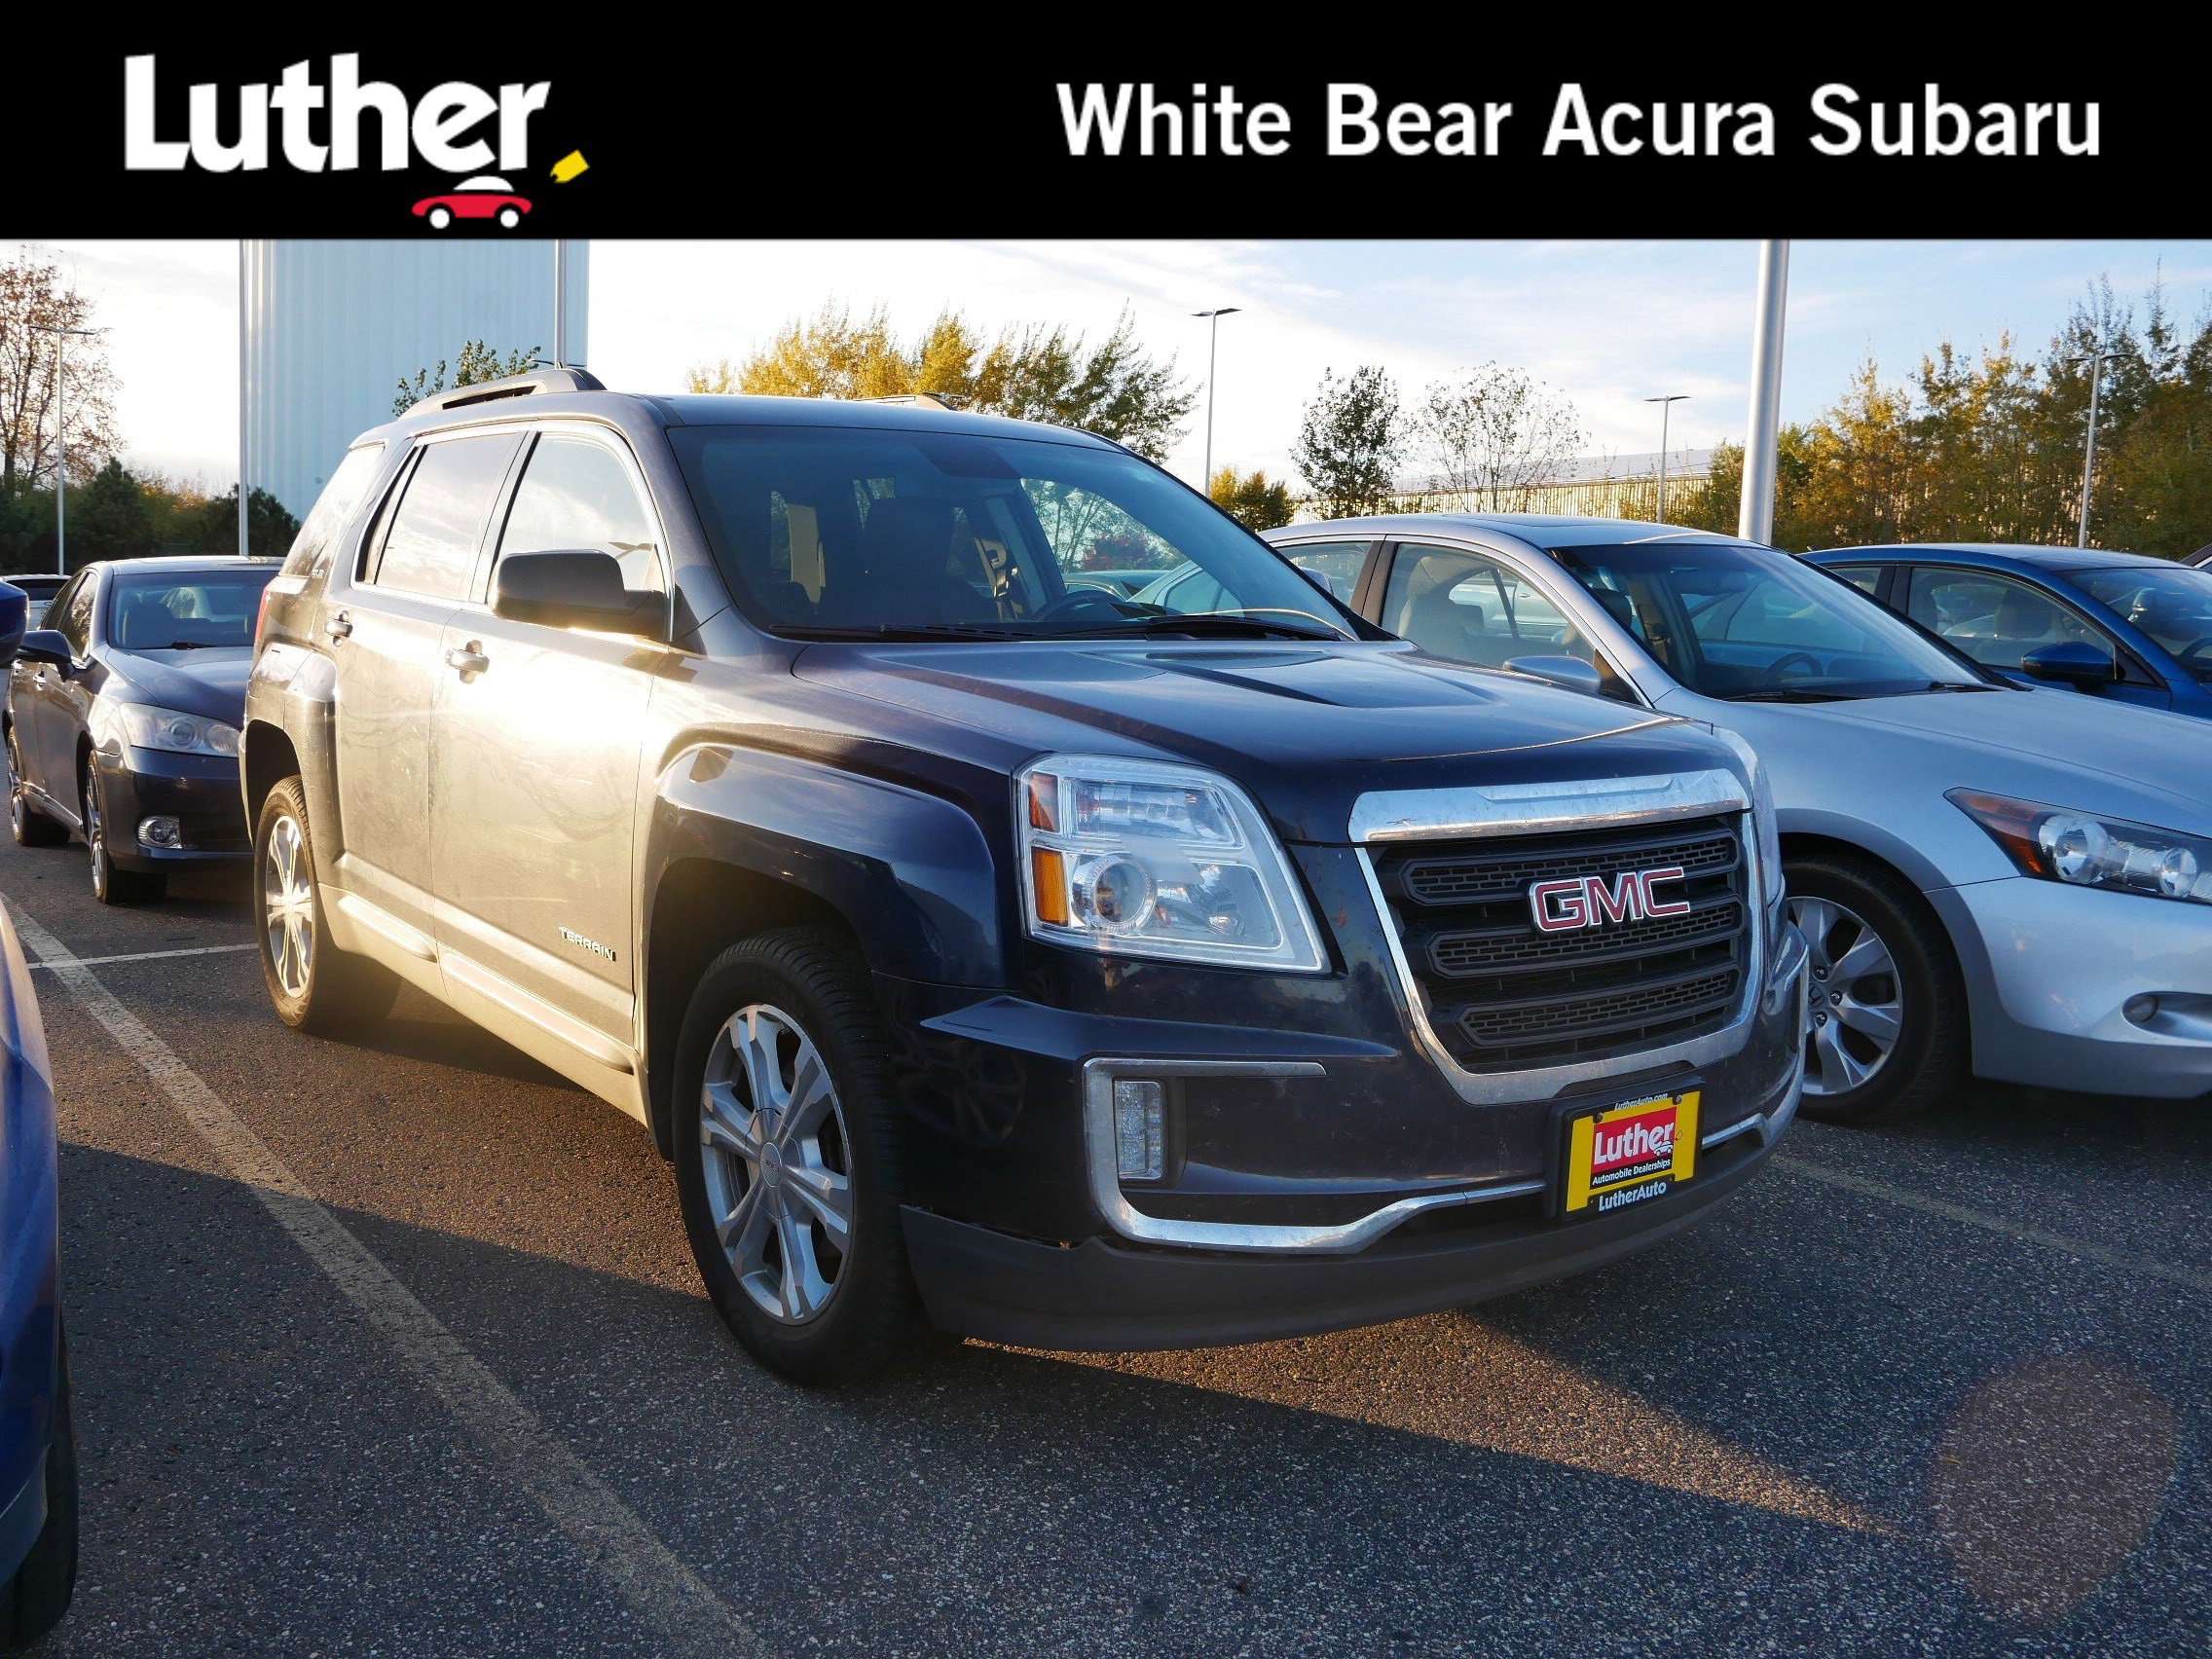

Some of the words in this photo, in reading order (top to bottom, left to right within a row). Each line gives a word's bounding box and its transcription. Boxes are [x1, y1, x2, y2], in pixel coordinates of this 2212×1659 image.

[1529, 866, 1690, 932] GMC
[559, 926, 616, 962] TERRAIN
[1613, 1093, 1669, 1112] LutherAuto.com
[1594, 1122, 1675, 1165] Luther
[1592, 1167, 1633, 1186] Automobile
[1633, 1159, 1671, 1175] Dealerships
[1599, 1181, 1668, 1212] LutherAuto
